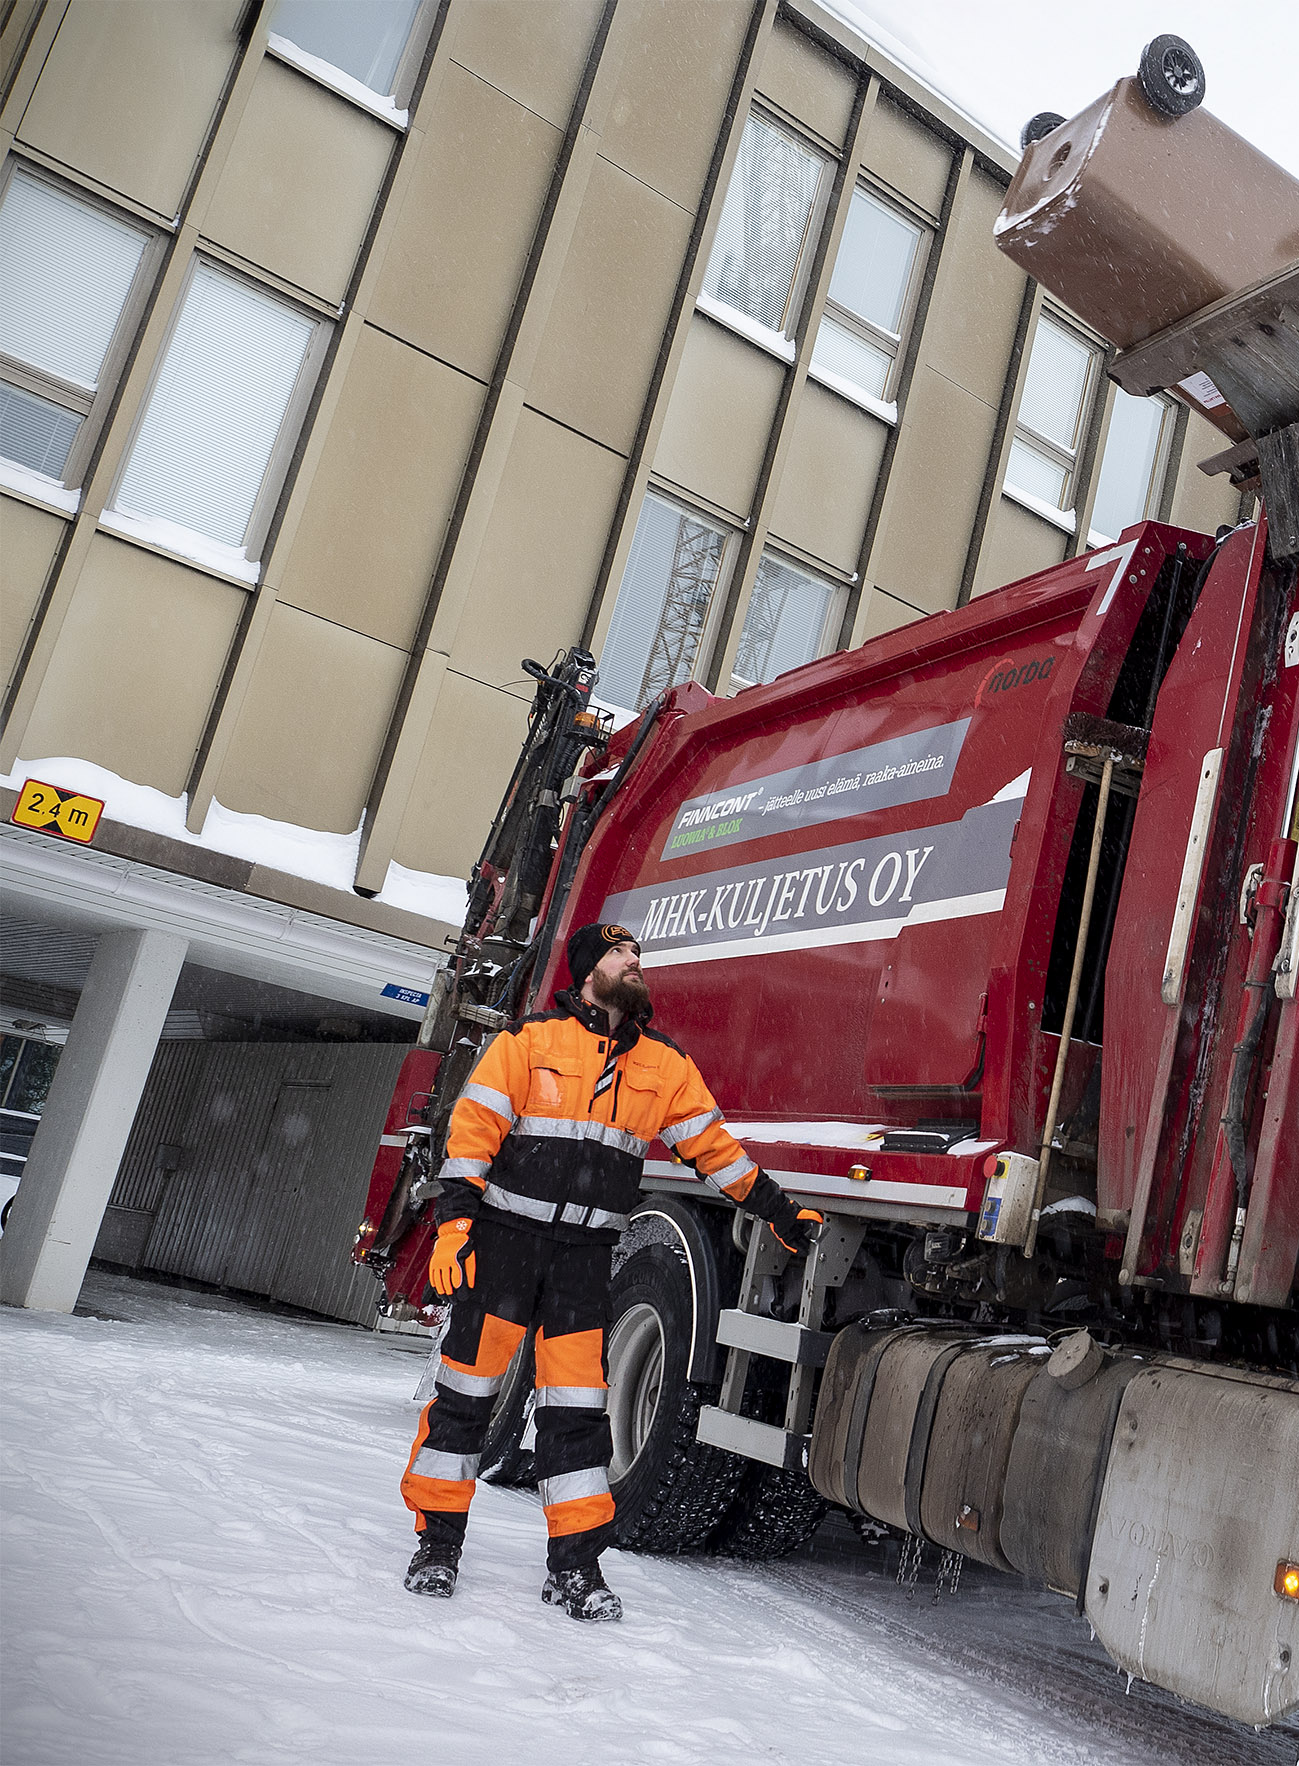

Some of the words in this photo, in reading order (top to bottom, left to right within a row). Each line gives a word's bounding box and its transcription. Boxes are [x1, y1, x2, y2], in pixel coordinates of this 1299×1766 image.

[761, 789, 805, 817] jätteelle
[804, 781, 829, 802] uusi
[826, 773, 863, 797] elämä,
[862, 753, 944, 787] raaka-aineina.
[67, 807, 89, 827] m
[715, 817, 744, 839] BLOK
[636, 857, 866, 942] MHK-KULJETUS
[868, 845, 935, 908] OY
